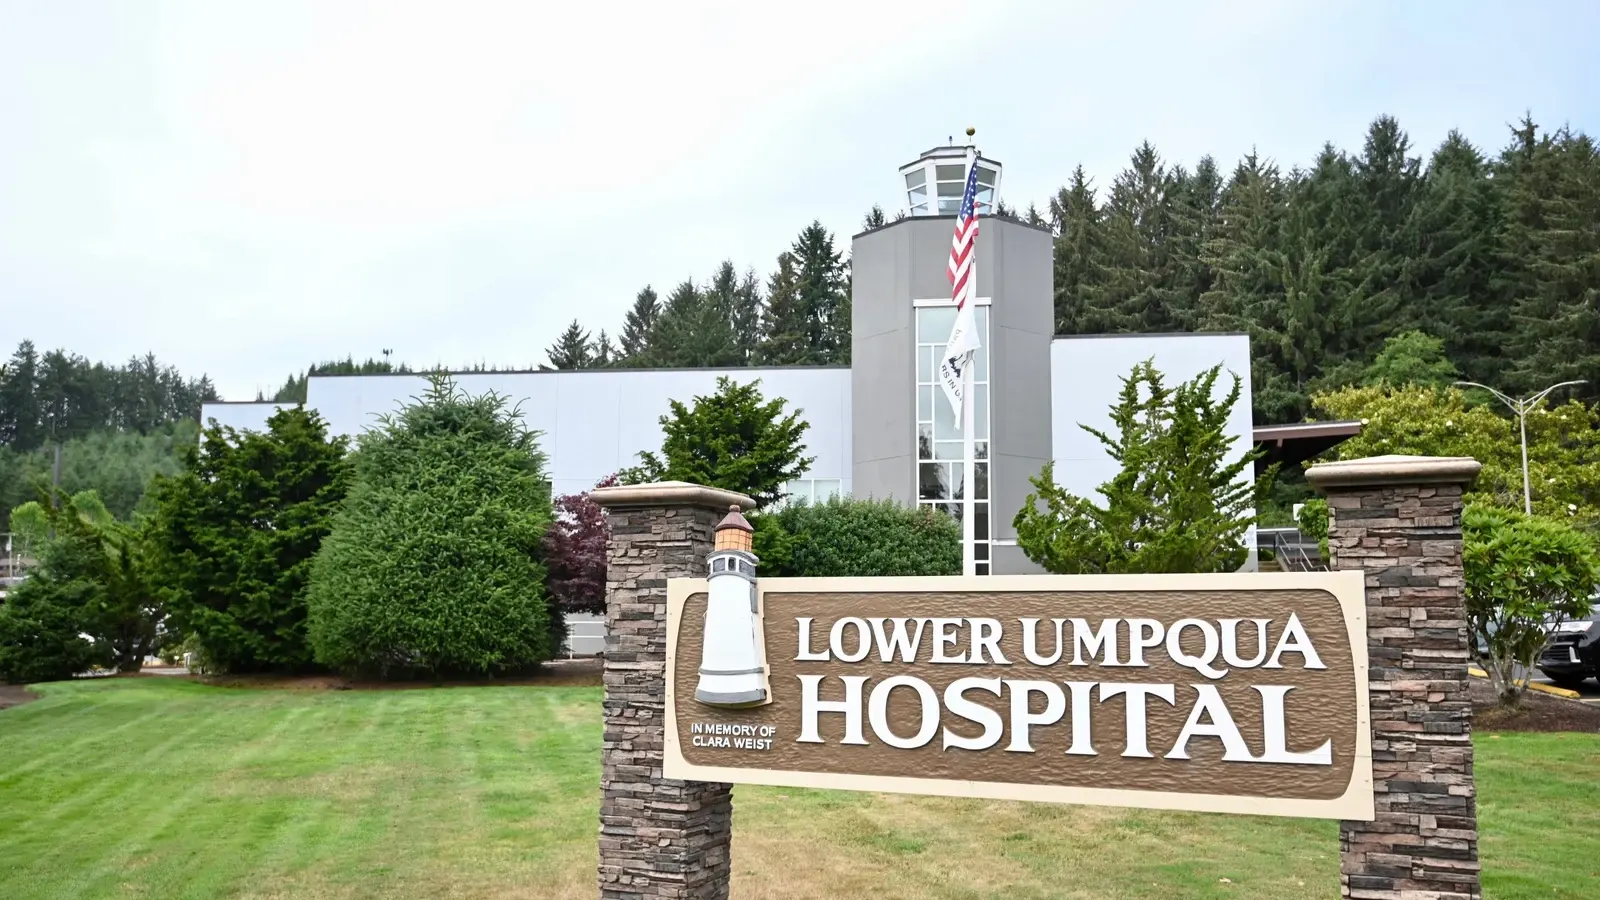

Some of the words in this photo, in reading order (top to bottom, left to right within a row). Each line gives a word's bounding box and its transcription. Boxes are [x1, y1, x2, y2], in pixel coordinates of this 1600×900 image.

[793, 616, 1013, 665] LOWER
[1018, 611, 1328, 680] UMPQUA
[691, 723, 703, 734] IN
[705, 723, 758, 737] MEMORY
[759, 725, 776, 737] OF
[795, 674, 1333, 765] HOSPITAL
[692, 735, 731, 748] CLARA
[733, 738, 773, 750] WEIST
